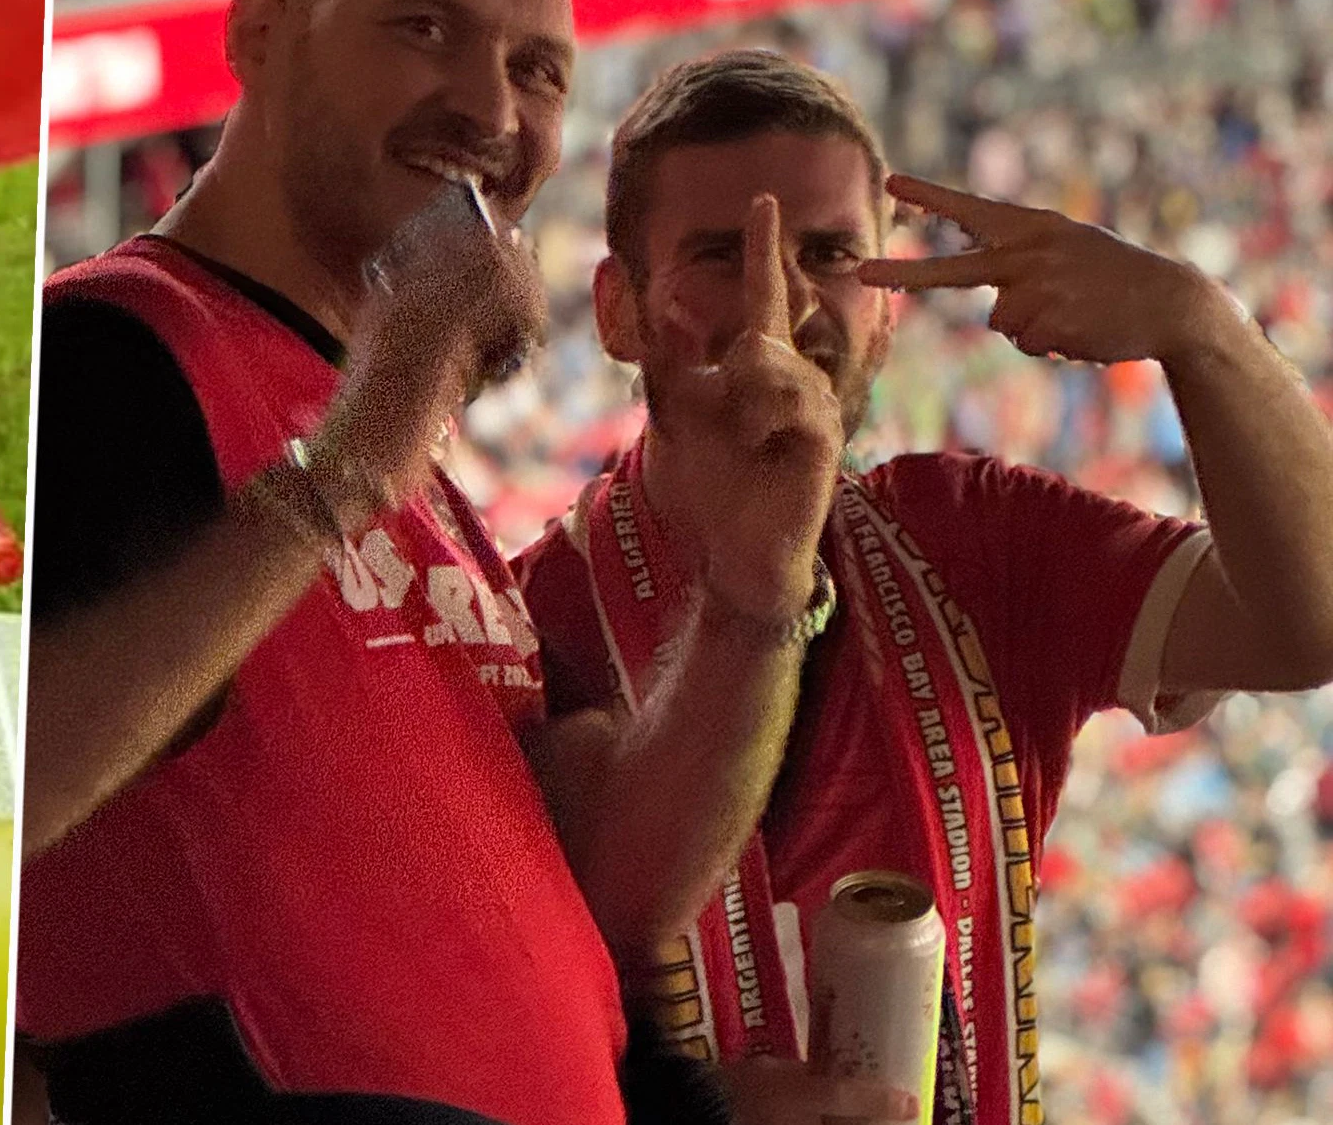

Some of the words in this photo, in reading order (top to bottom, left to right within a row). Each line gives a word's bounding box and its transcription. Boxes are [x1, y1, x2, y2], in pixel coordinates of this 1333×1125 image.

[852, 524, 916, 647] FRANCISCO
[901, 651, 934, 701] BAY
[918, 708, 956, 779] AREA
[937, 784, 973, 890] STADION
[723, 871, 766, 1029] ARGENTINI
